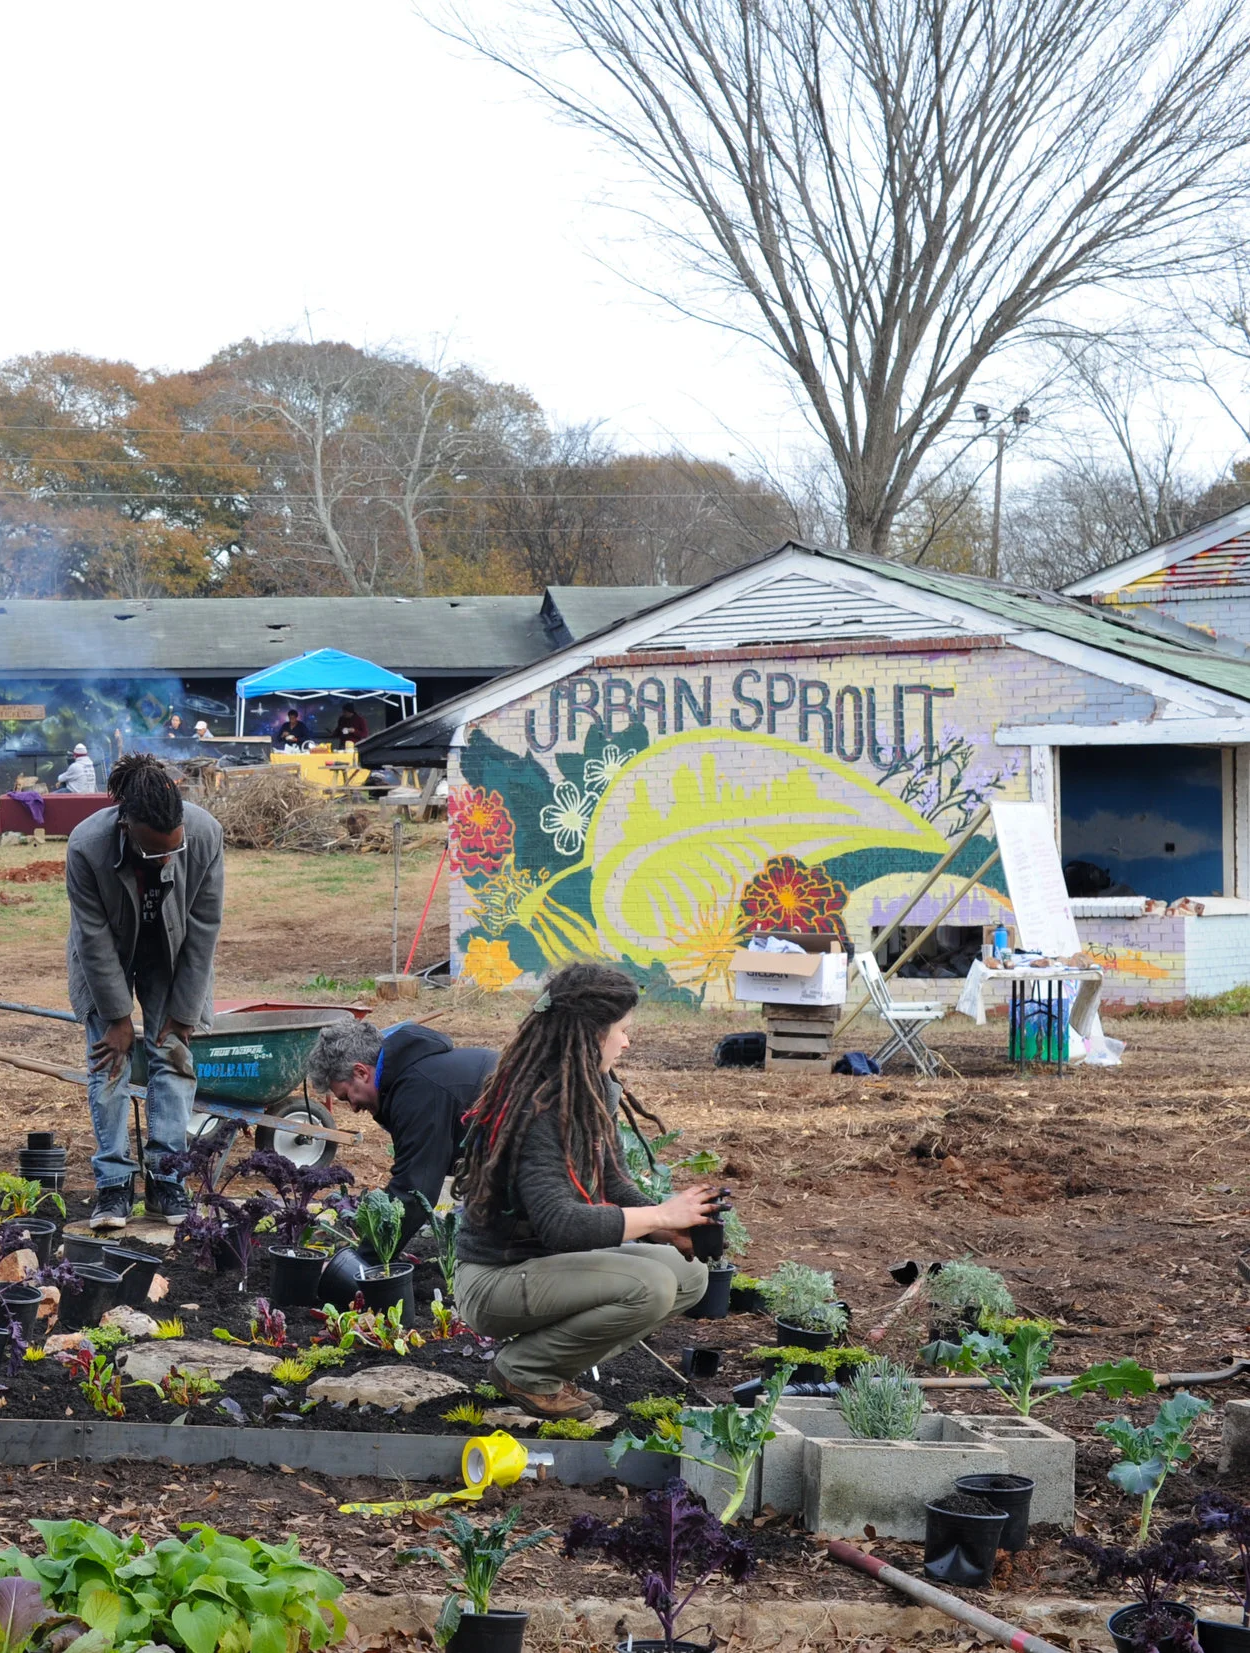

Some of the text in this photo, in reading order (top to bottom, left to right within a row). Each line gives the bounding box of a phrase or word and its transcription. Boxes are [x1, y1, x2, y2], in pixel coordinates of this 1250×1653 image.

[525, 669, 955, 775] URBAN SPROUT
[197, 1061, 260, 1078] TOOLBANK
